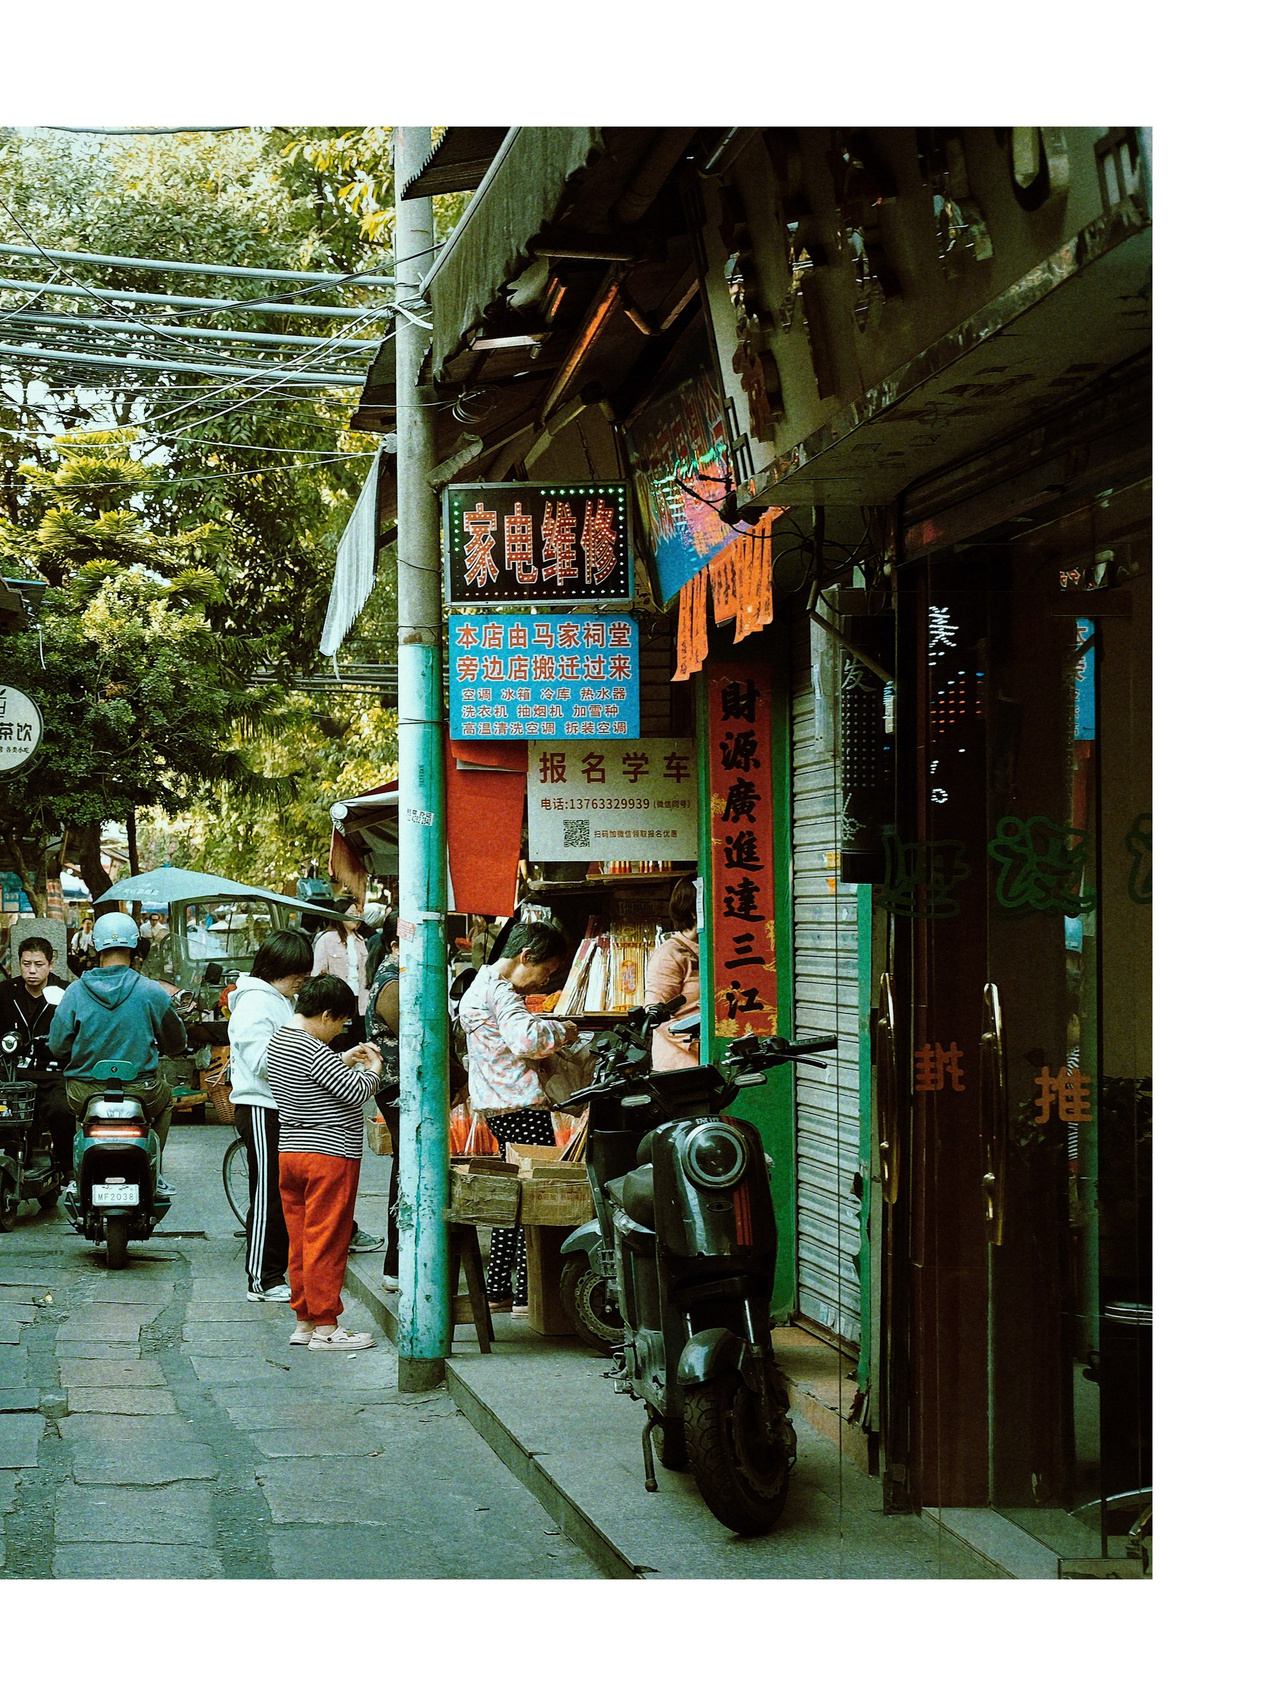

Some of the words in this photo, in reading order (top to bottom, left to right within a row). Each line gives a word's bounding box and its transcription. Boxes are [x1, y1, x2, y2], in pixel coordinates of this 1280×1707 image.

[463, 499, 617, 587] 家电维修
[456, 622, 632, 649] 本店由马家祠堂
[456, 654, 632, 682] 旁边店搬迁过来
[462, 688, 491, 701] 空调
[501, 688, 531, 701] 冰箱
[540, 688, 571, 701] 冷库
[580, 688, 627, 701] 热水器
[462, 705, 508, 718] 洗衣机
[517, 705, 563, 718] 抽烟机
[573, 705, 619, 718] 加雪种
[462, 722, 556, 735] 高温清洗空调
[565, 722, 628, 735] 拆装空调
[539, 751, 691, 784] 报名学车
[540, 797, 650, 811] 电话:13763329939
[1034, 1066, 1093, 1124] 推
